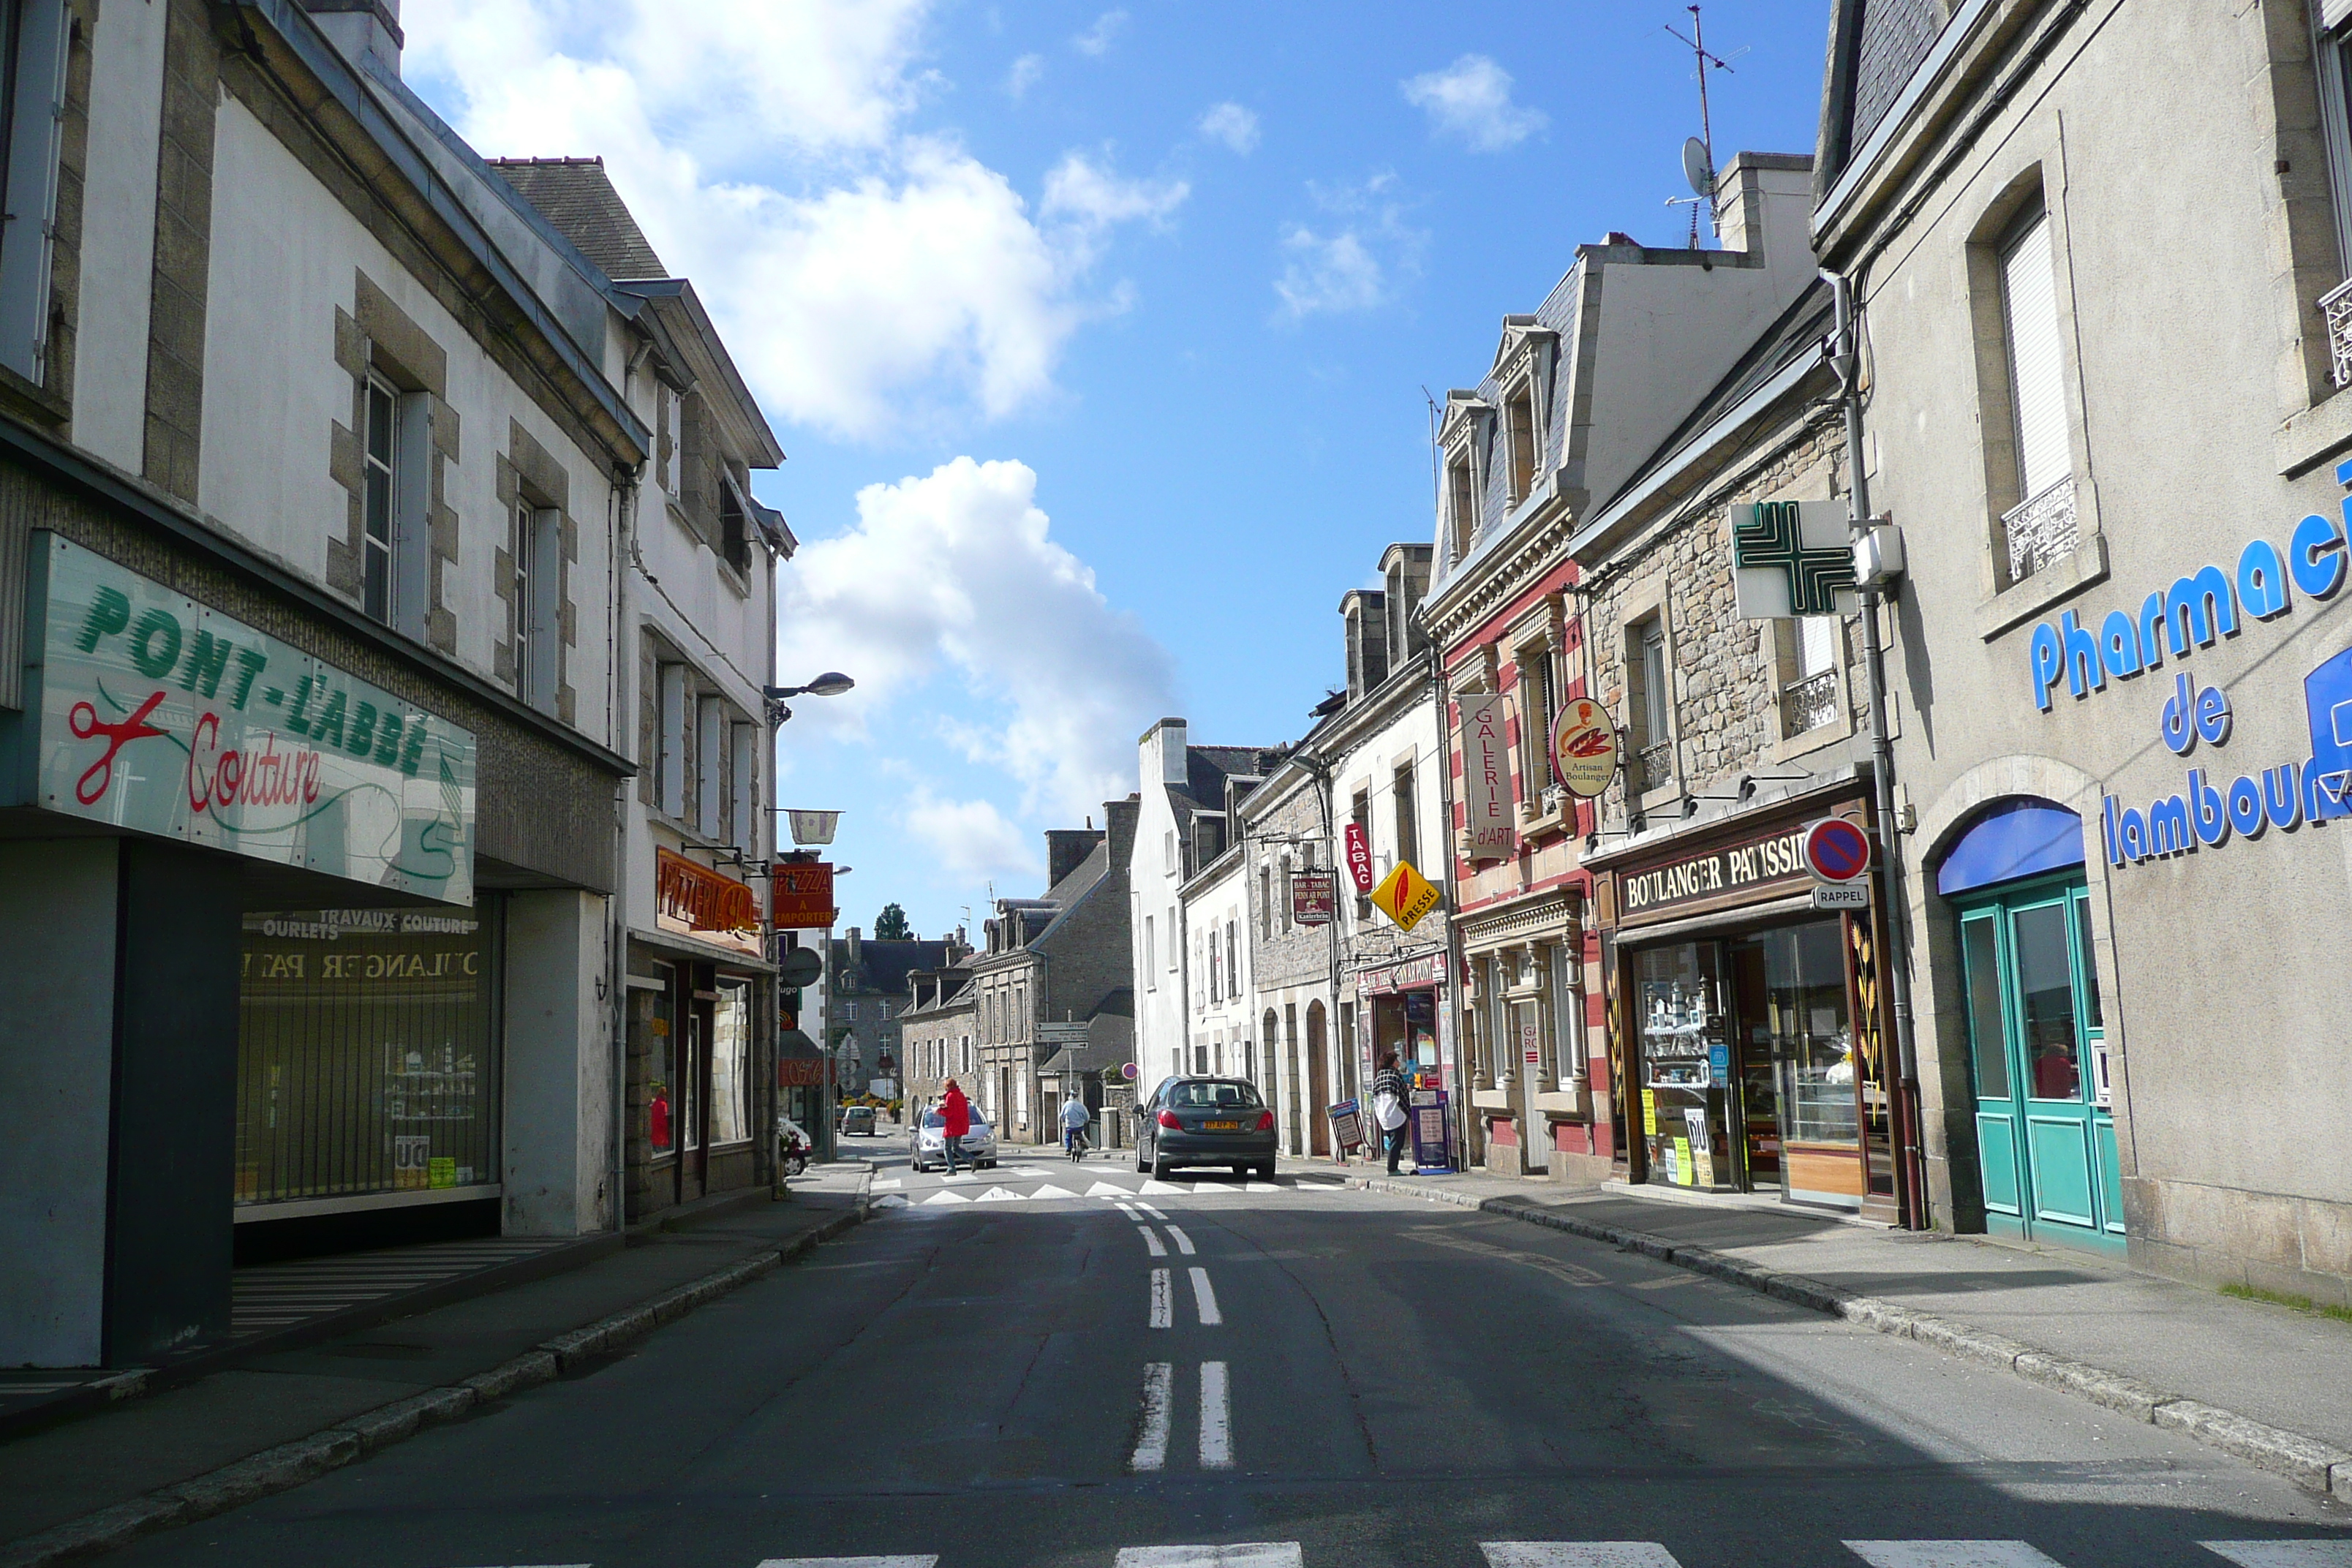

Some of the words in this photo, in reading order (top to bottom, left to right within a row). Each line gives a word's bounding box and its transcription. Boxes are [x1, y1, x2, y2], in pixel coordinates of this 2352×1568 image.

[2160, 671, 2231, 752] de
[189, 712, 320, 812] Couture
[1475, 709, 1501, 817] GALERIE
[1572, 763, 1603, 772] Artisan
[1566, 772, 1610, 782] Boulanger
[1478, 826, 1512, 845] d'ART
[1349, 829, 1369, 883] TABAC
[774, 868, 832, 896] PIZZA
[1311, 881, 1330, 889] TABAC
[1627, 856, 1723, 908] BOULANGER
[664, 862, 723, 932] PIZZERIA
[1401, 889, 1435, 925] PRESSE
[1820, 892, 1863, 902] RAPPEL
[263, 919, 339, 941] OURLETS
[403, 914, 469, 935] COUTURE
[775, 912, 832, 924] EMPORTER
[779, 987, 798, 995] ugo
[1687, 1120, 1708, 1152] DU
